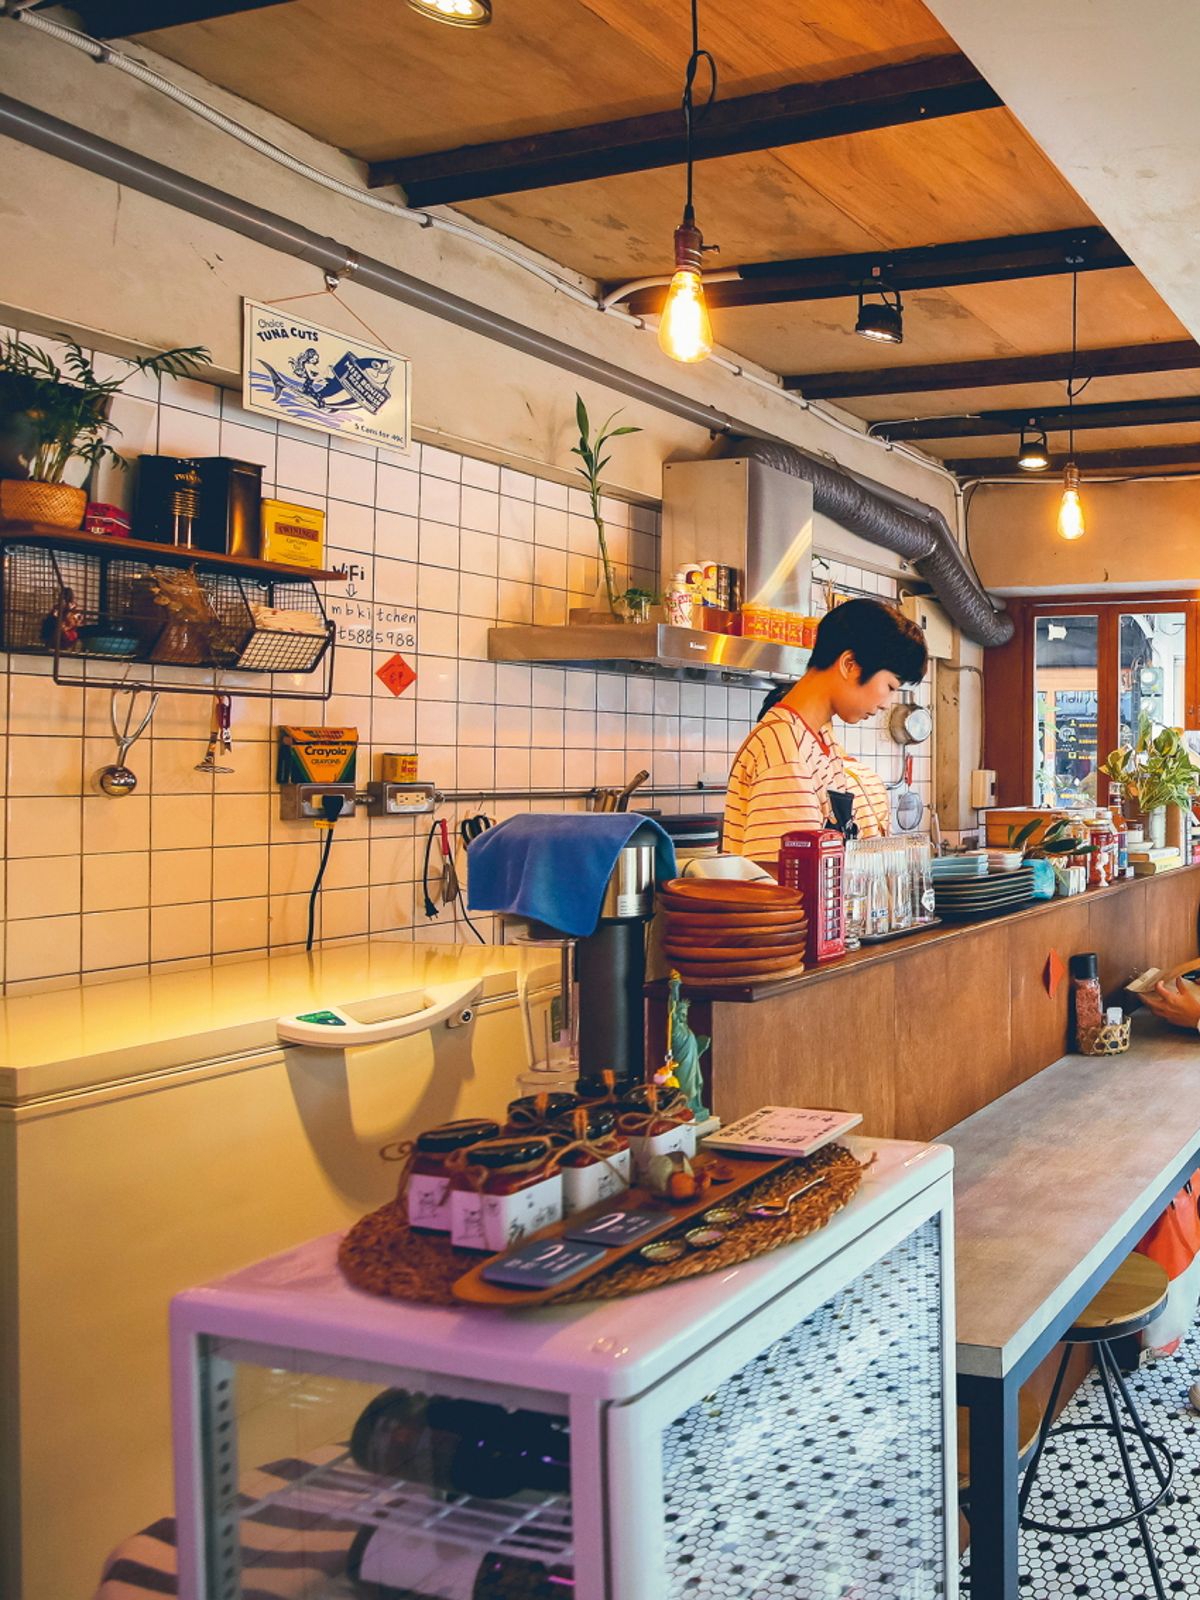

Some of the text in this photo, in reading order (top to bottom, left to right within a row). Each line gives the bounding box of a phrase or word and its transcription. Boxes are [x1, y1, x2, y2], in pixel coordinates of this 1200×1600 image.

[258, 318, 285, 328] Choice
[256, 326, 319, 342] TUNA CUTS
[304, 745, 347, 757] Crayola
